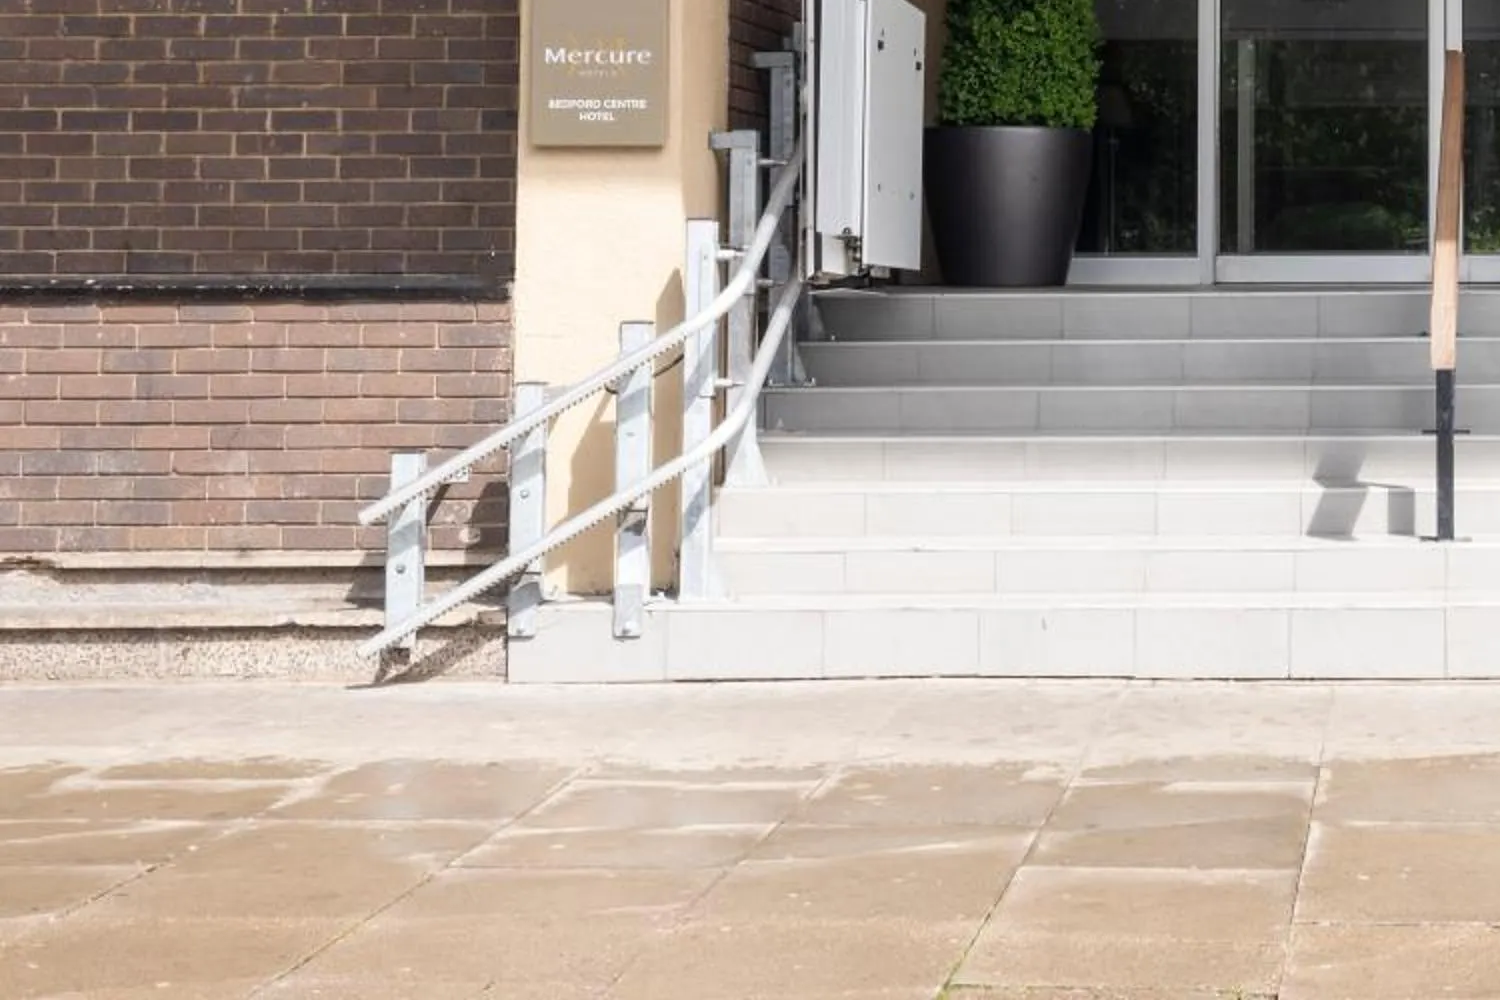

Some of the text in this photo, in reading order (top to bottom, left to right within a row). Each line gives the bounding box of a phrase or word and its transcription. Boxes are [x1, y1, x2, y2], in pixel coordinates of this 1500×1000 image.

[544, 47, 652, 64] Mercure
[548, 98, 648, 109] BEDFORD CENTRE
[579, 111, 615, 121] HOTEL
